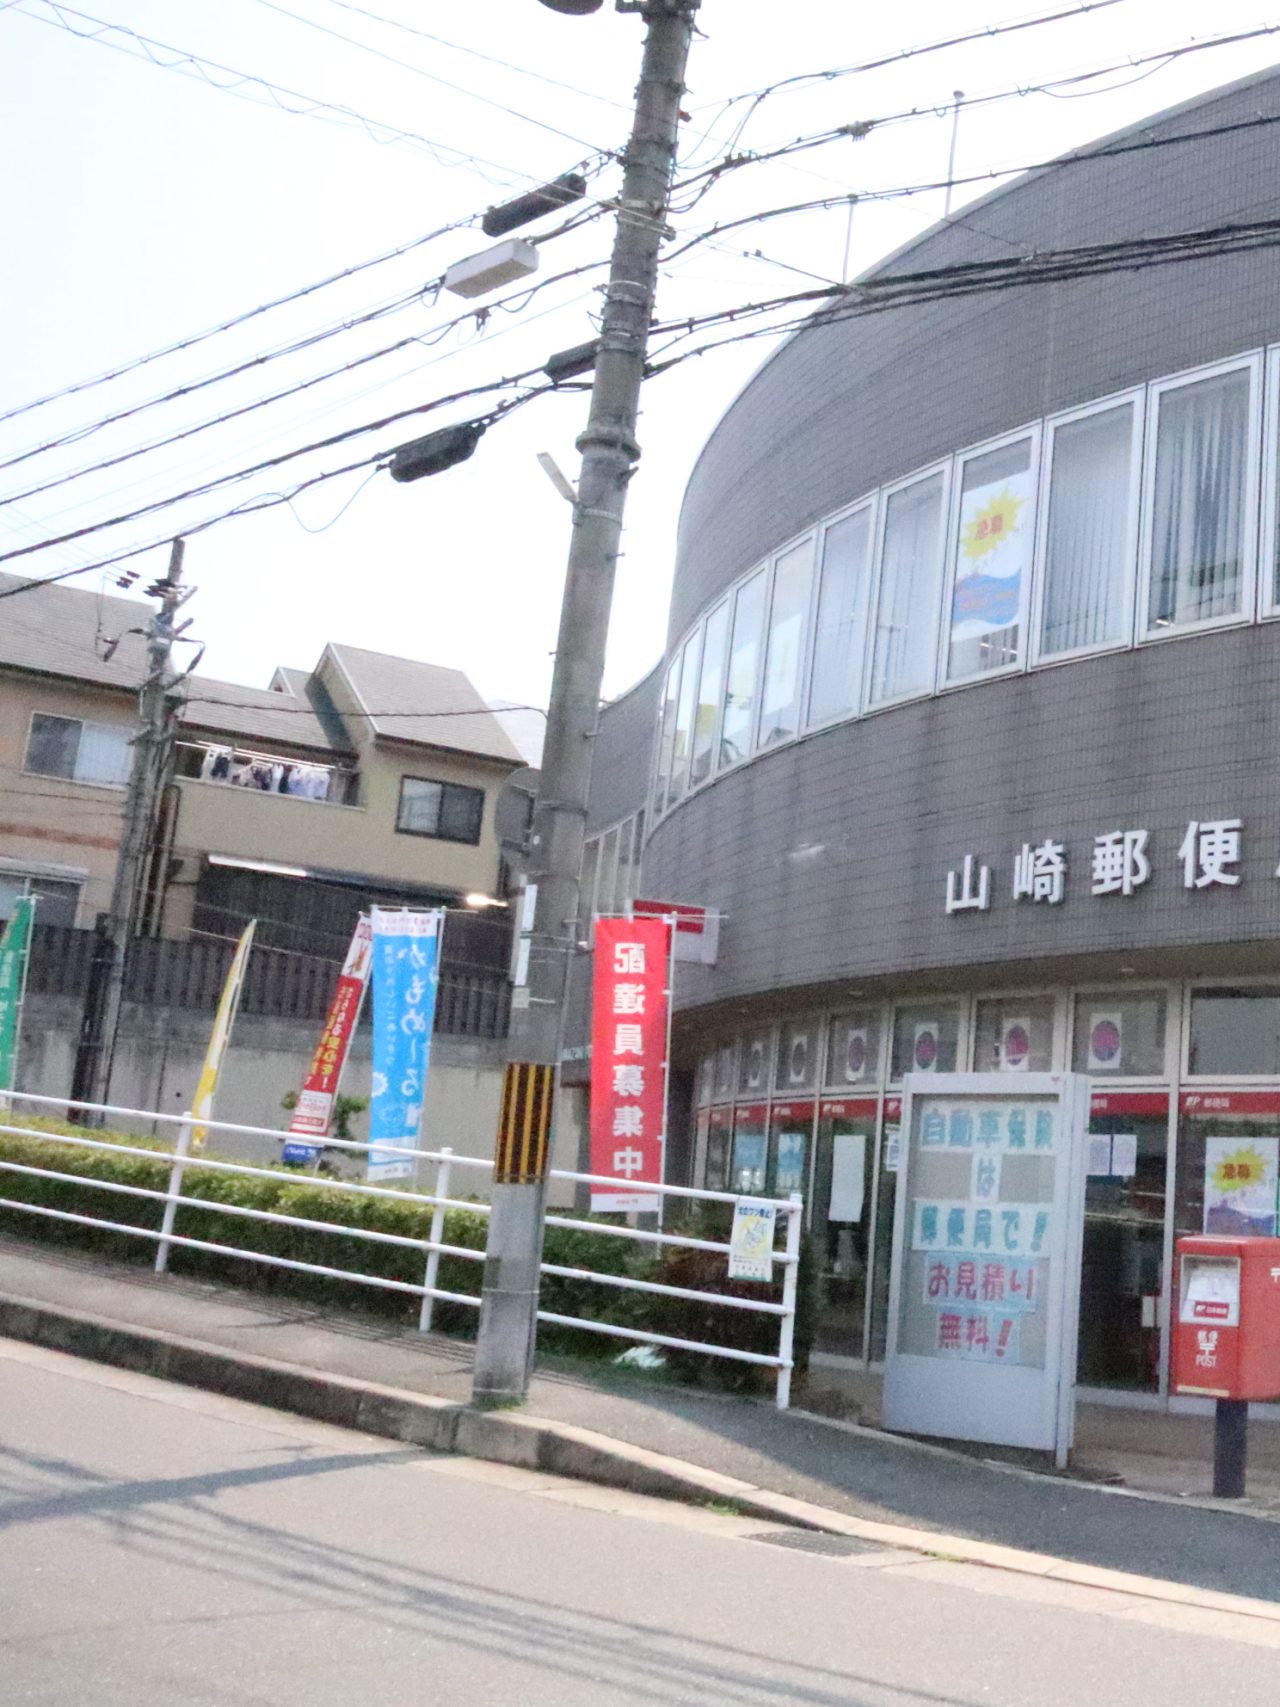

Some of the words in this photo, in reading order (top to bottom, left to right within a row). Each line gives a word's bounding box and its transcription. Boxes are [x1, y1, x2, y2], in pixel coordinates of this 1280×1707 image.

[976, 1158, 996, 1197] は
[928, 1260, 1034, 1301] お見積り
[938, 1312, 1014, 1358] 無料!
[1195, 1354, 1217, 1368] POST
